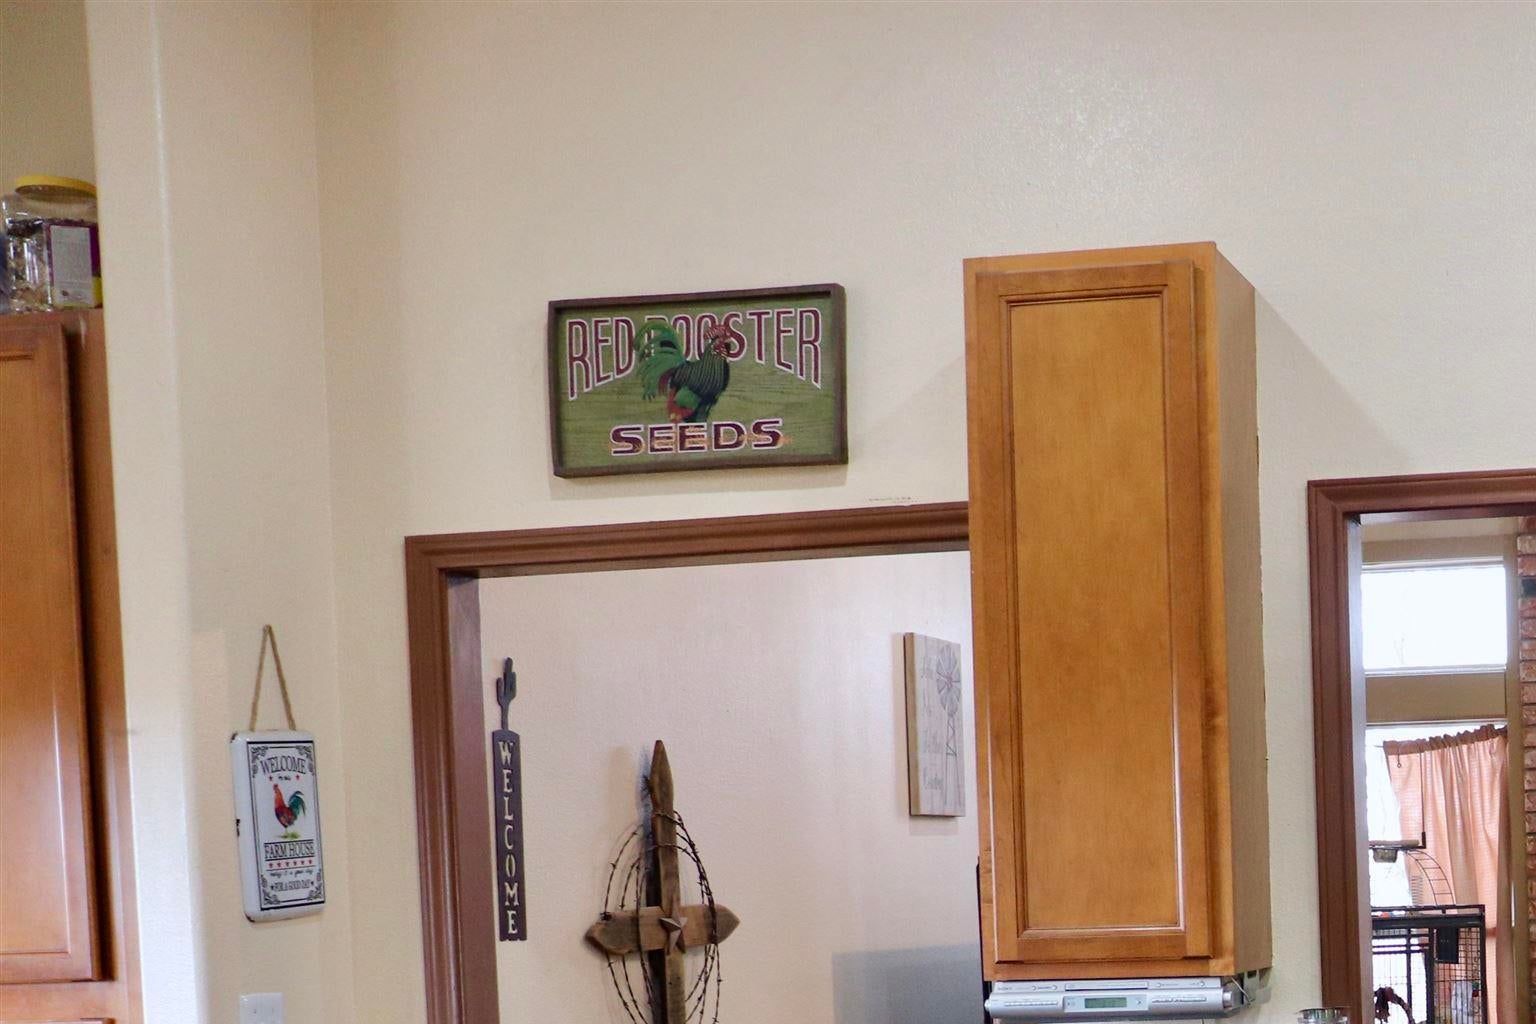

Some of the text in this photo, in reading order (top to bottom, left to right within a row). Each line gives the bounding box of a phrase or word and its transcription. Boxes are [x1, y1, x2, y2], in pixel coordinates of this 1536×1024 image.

[567, 307, 822, 401] RED OOSTER
[611, 418, 783, 457] SEEDS
[260, 755, 307, 776] WELCOME
[264, 841, 315, 859] FARM HOUSE
[498, 741, 519, 934] WELCOME
